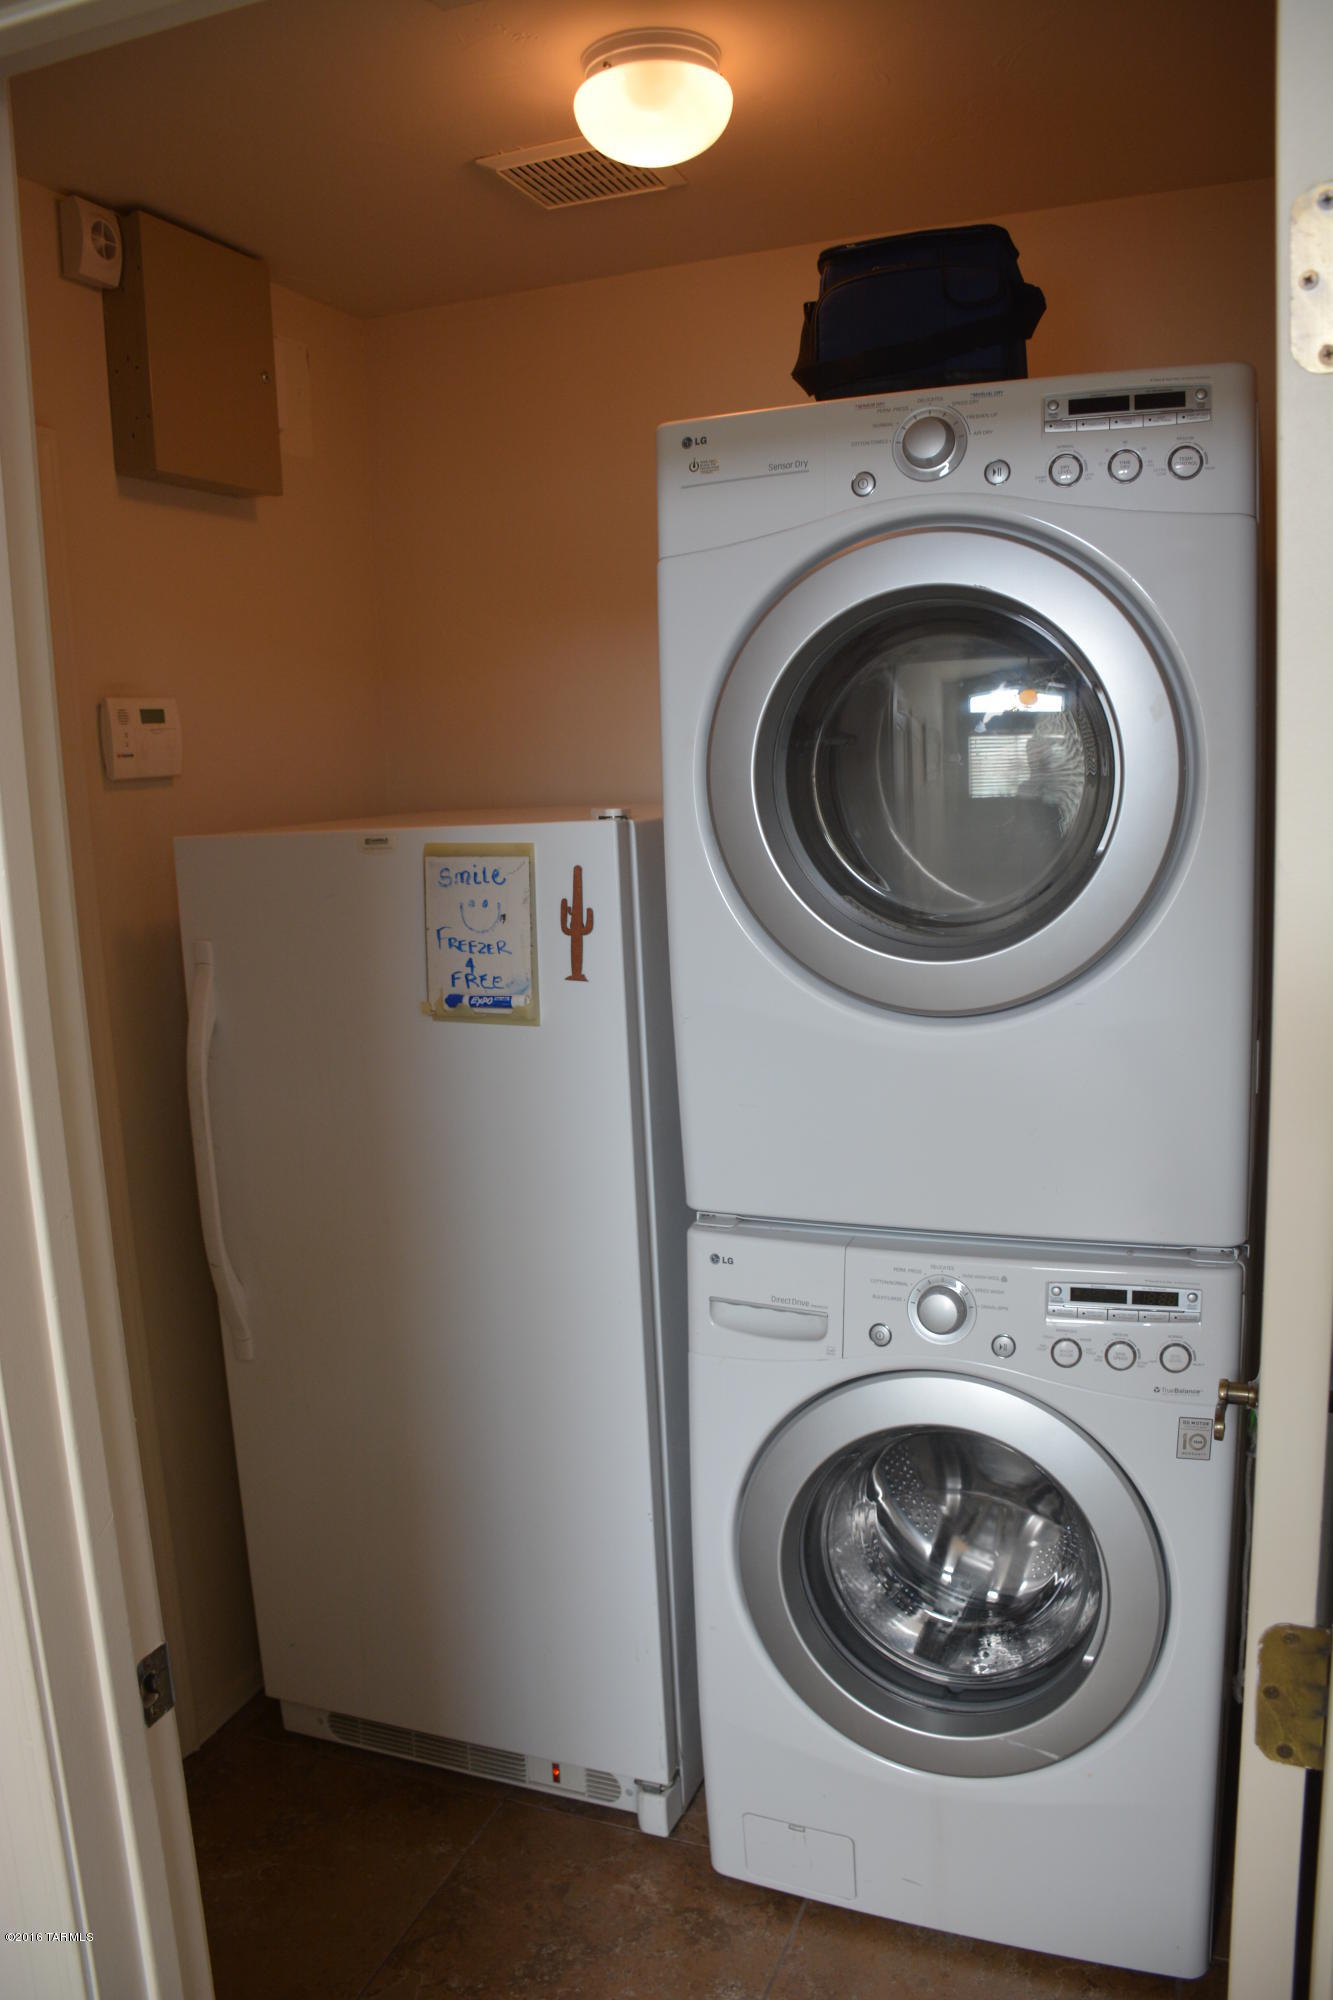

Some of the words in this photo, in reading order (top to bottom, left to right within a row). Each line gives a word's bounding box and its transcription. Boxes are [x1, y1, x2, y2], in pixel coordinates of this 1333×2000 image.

[767, 461, 793, 473] Sensor
[794, 458, 809, 470] Dry
[436, 926, 513, 955] FREEZER
[450, 971, 505, 990] FREE
[771, 1295, 791, 1305] Direct
[791, 1296, 810, 1307] Drive
